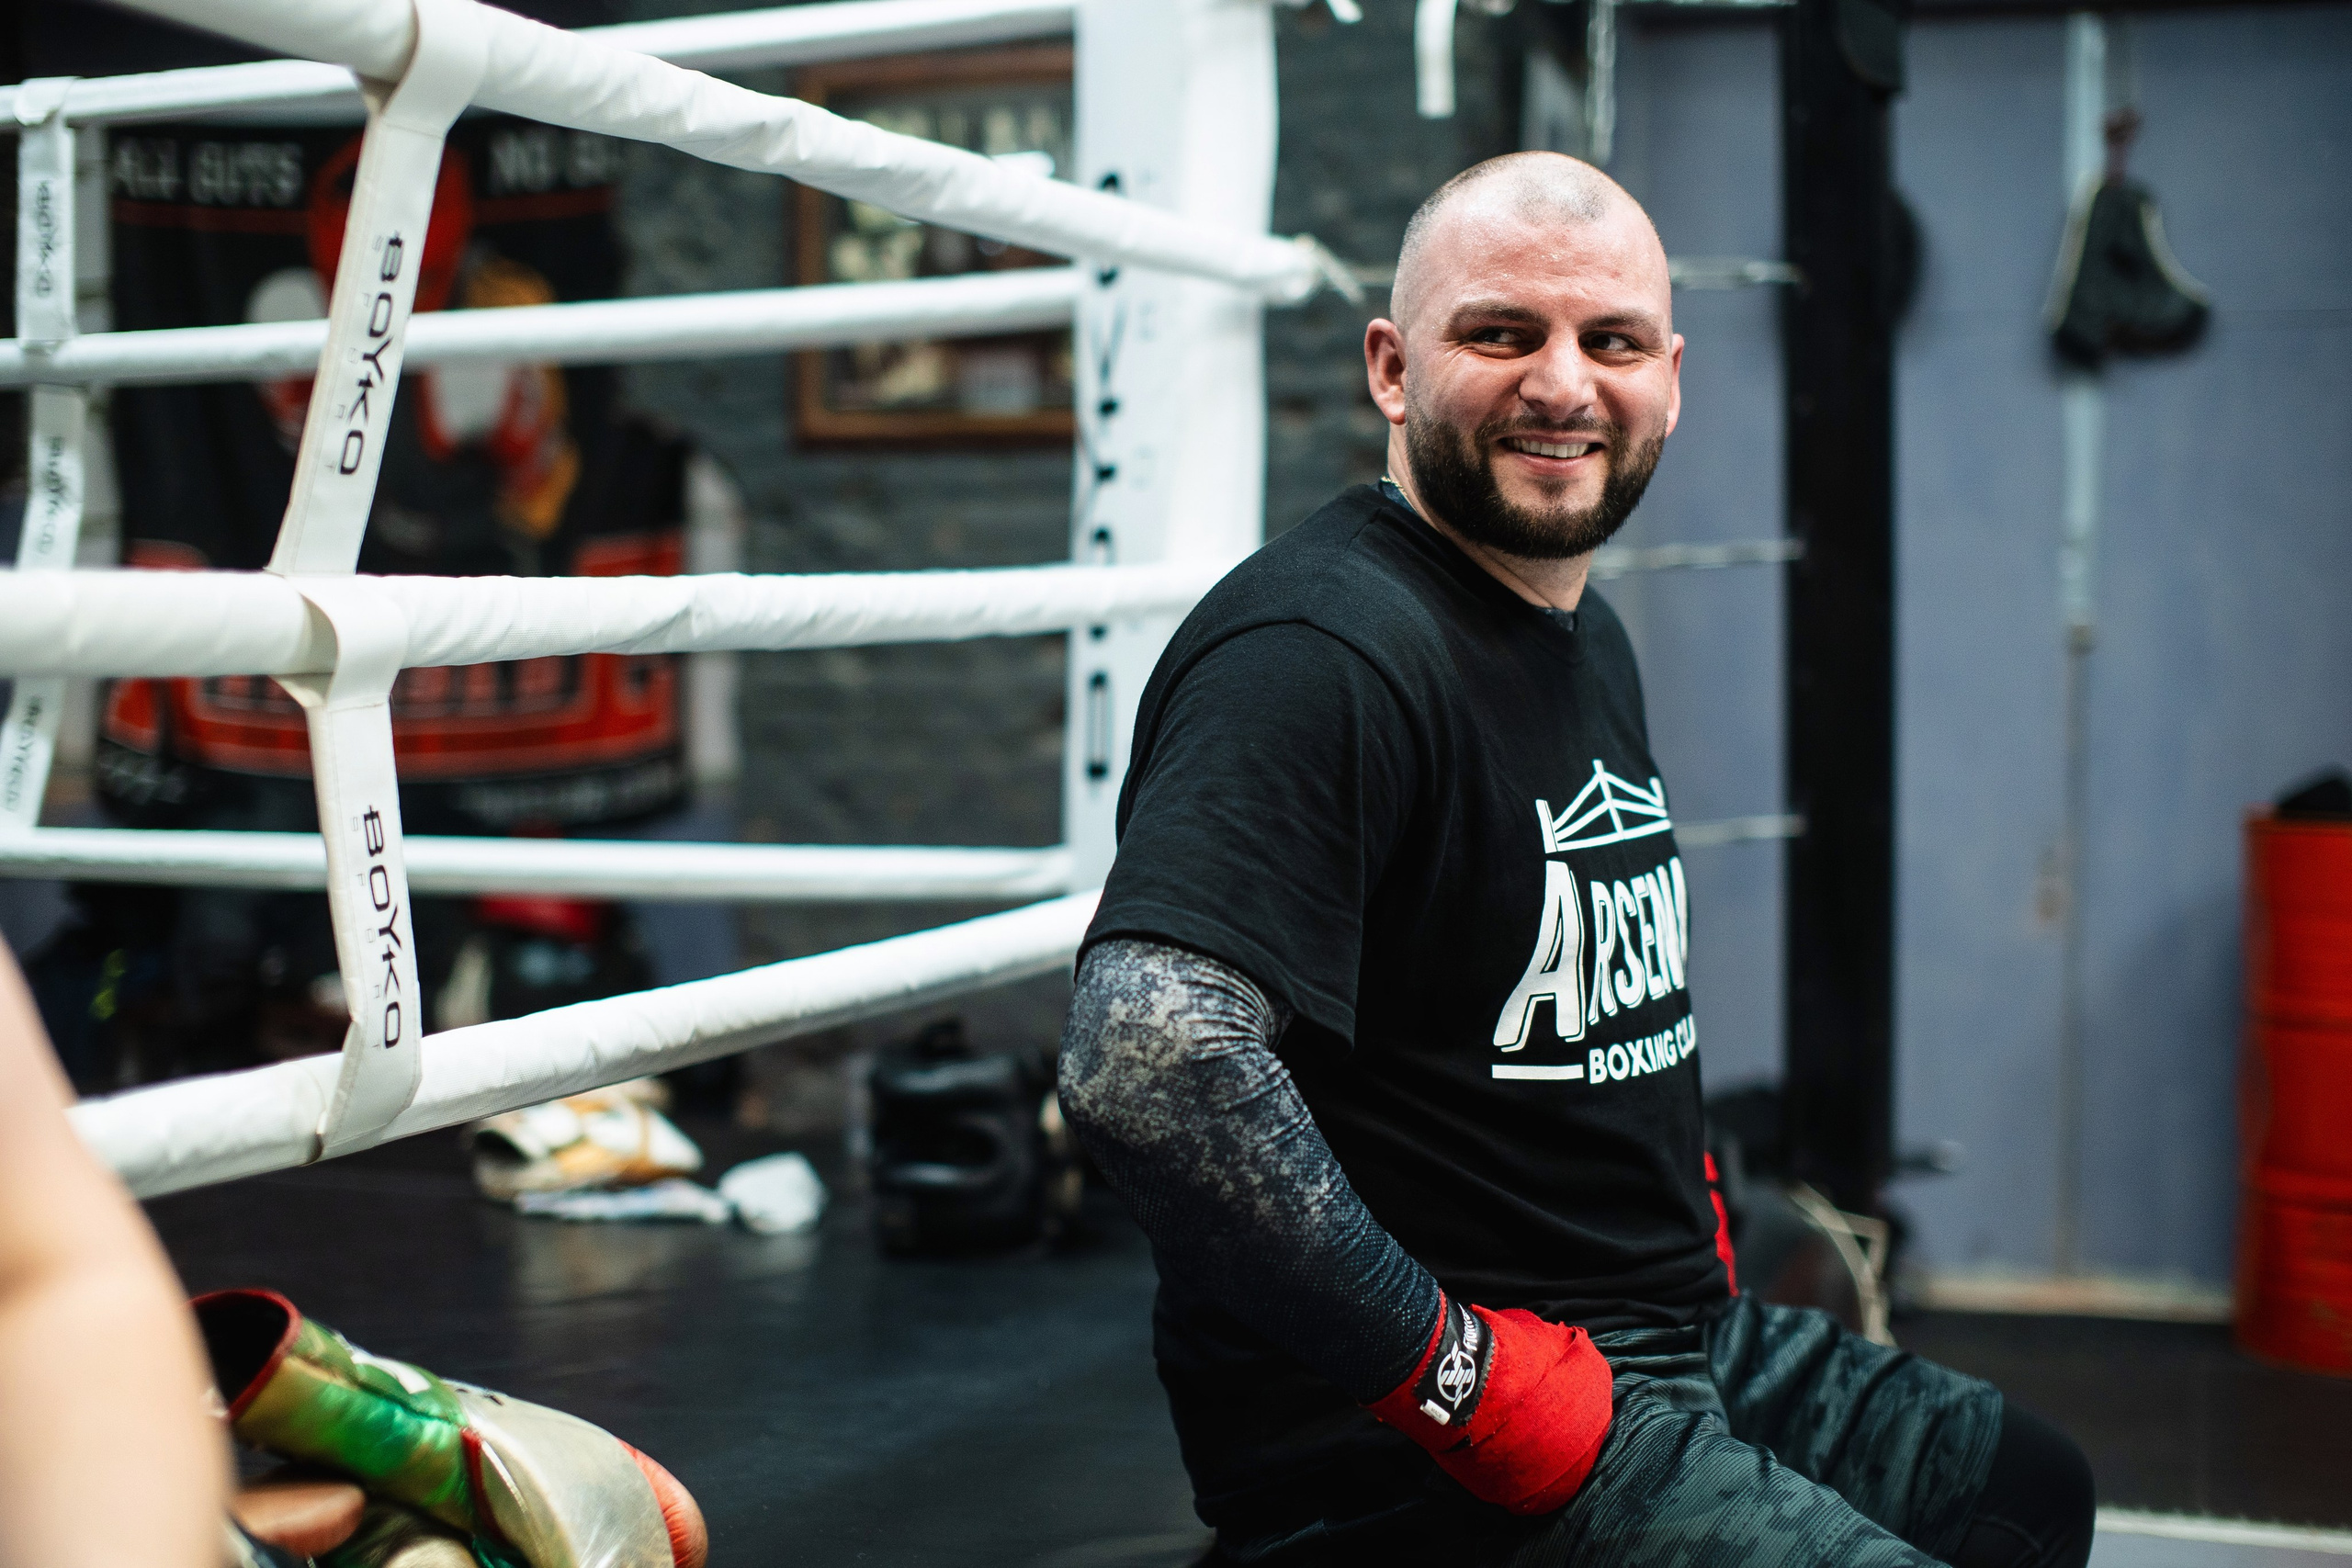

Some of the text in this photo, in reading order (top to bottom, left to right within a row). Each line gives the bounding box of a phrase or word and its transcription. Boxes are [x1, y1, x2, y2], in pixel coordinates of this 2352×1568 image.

[190, 141, 304, 206] GUTS
[338, 229, 404, 476] BOYKO
[363, 804, 403, 1049] BOYKO
[1589, 1028, 1678, 1085] BOXING
